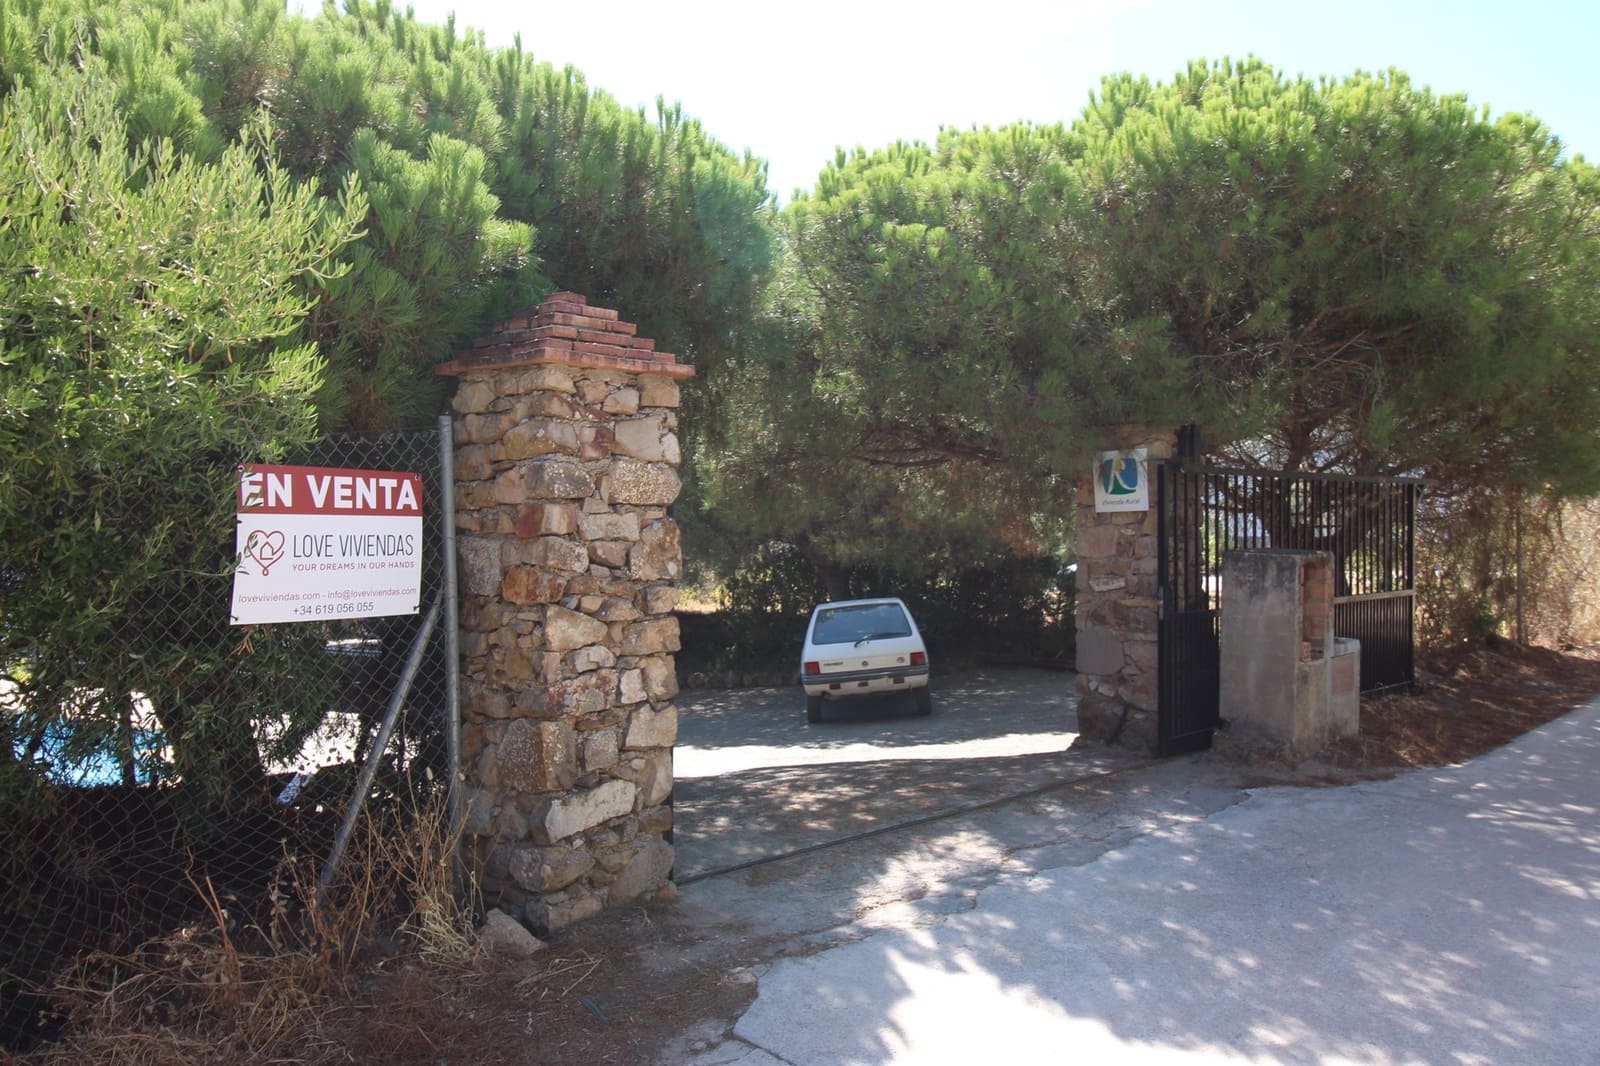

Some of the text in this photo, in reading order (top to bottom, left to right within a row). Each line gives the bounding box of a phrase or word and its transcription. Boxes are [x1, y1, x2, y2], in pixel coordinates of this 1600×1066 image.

[241, 472, 418, 510] EN VENTA
[293, 534, 414, 558] LOVE VIVIENDAS
[293, 563, 317, 571] YOUR
[320, 562, 355, 570] DREAMS
[369, 561, 386, 569] OUR
[388, 561, 415, 569] HANDS
[238, 592, 320, 603] loveviviendas.com
[327, 588, 417, 600] info@loveviviendas.com
[293, 601, 374, 615] +34 619 056 055
